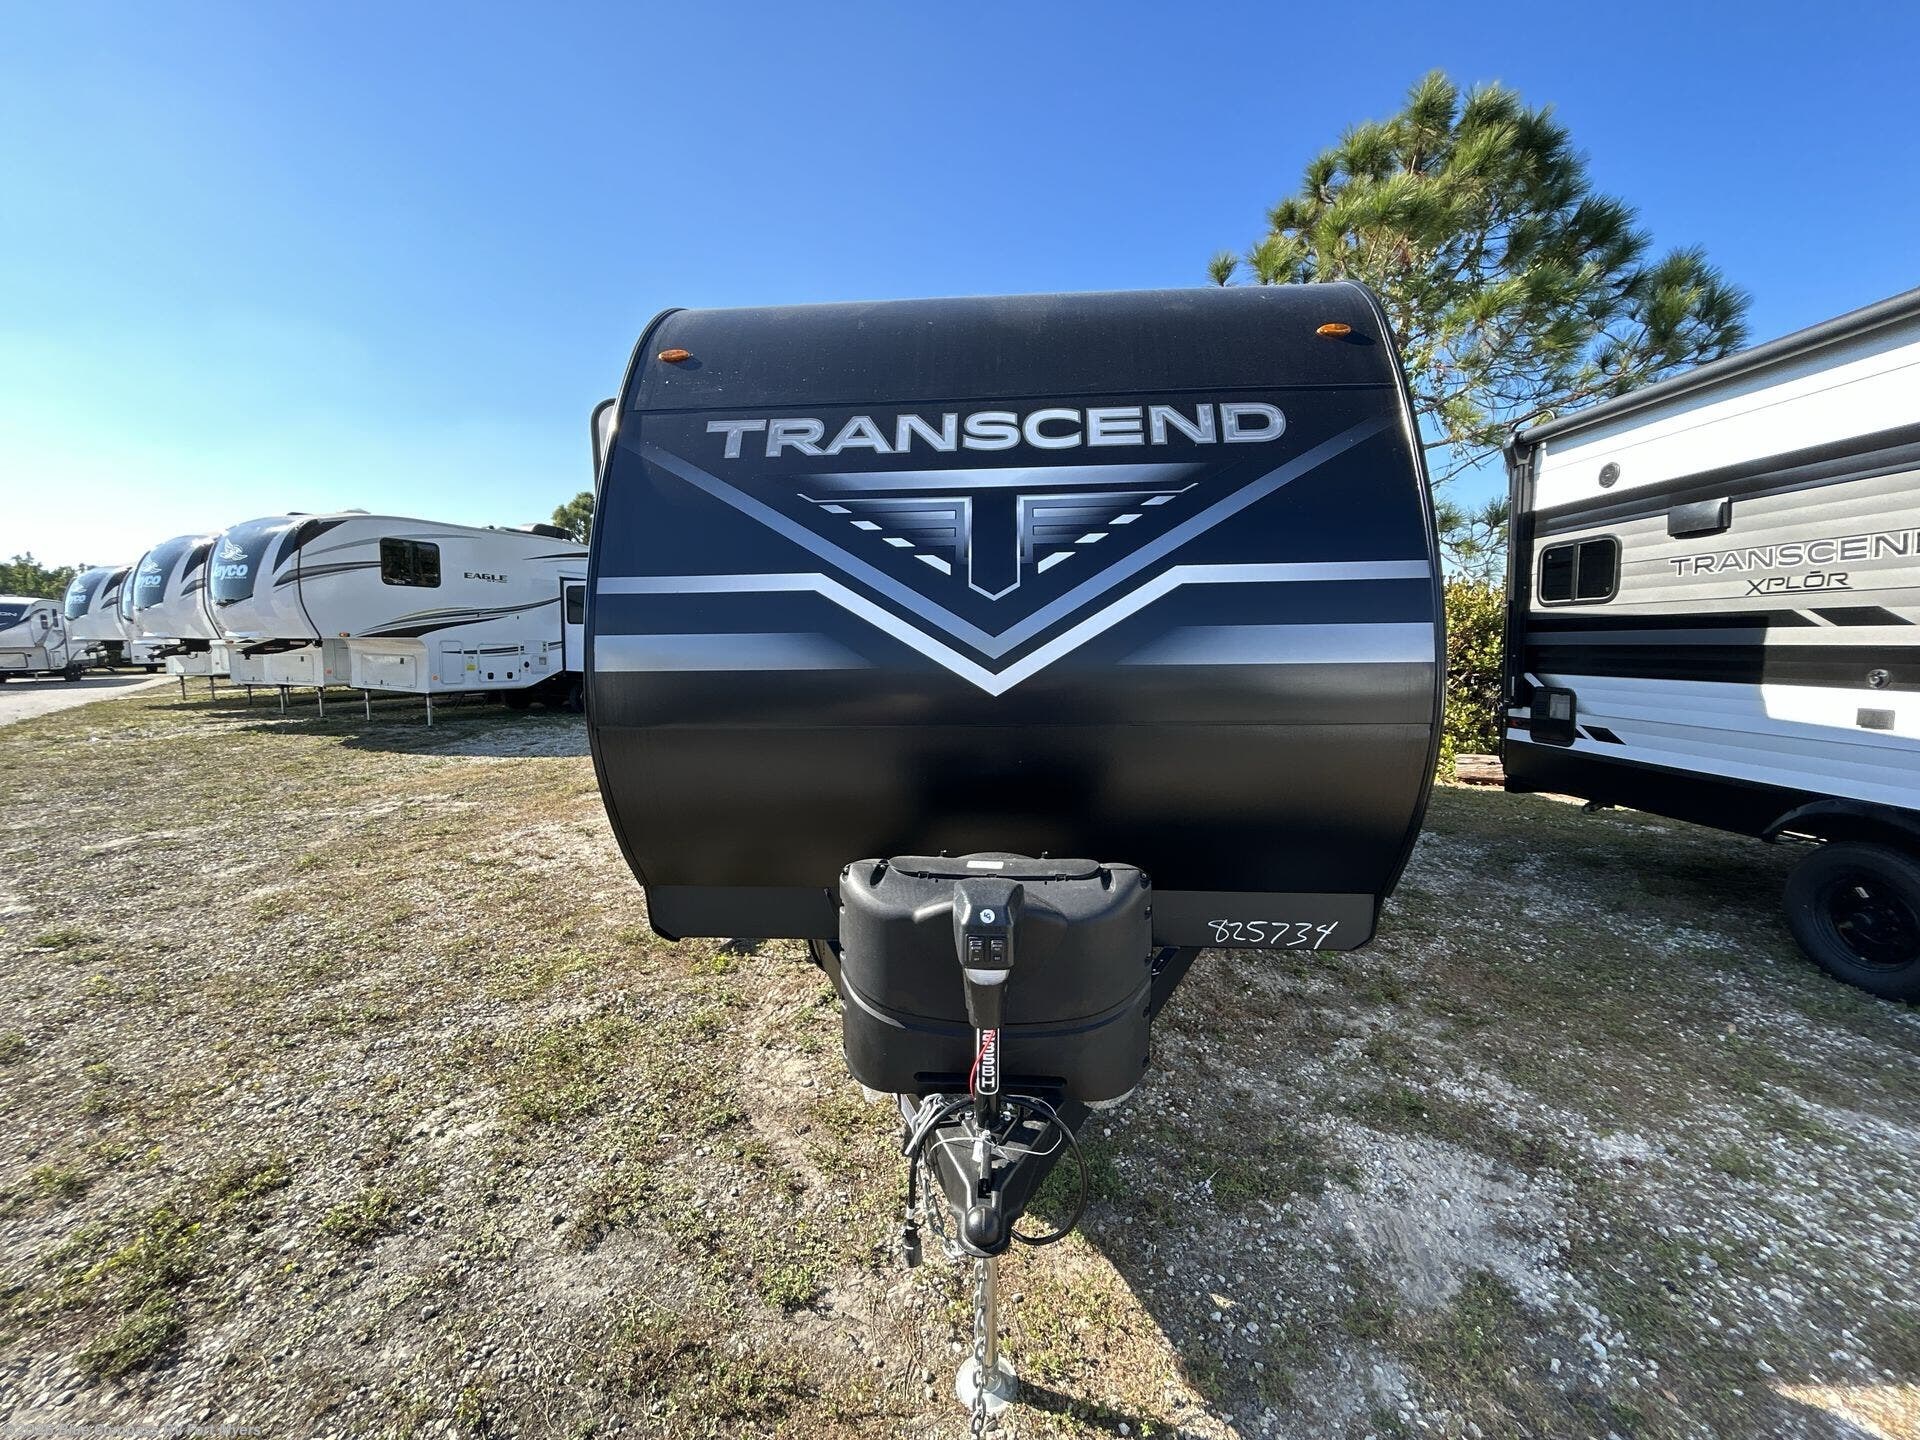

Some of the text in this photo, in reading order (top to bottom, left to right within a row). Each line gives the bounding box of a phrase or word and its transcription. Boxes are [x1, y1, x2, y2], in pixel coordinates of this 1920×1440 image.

[705, 402, 1287, 459] TRANSCEND
[1669, 528, 1920, 578] TRANSCEN
[463, 571, 508, 582] EAGLE
[1208, 919, 1339, 949] 825734
